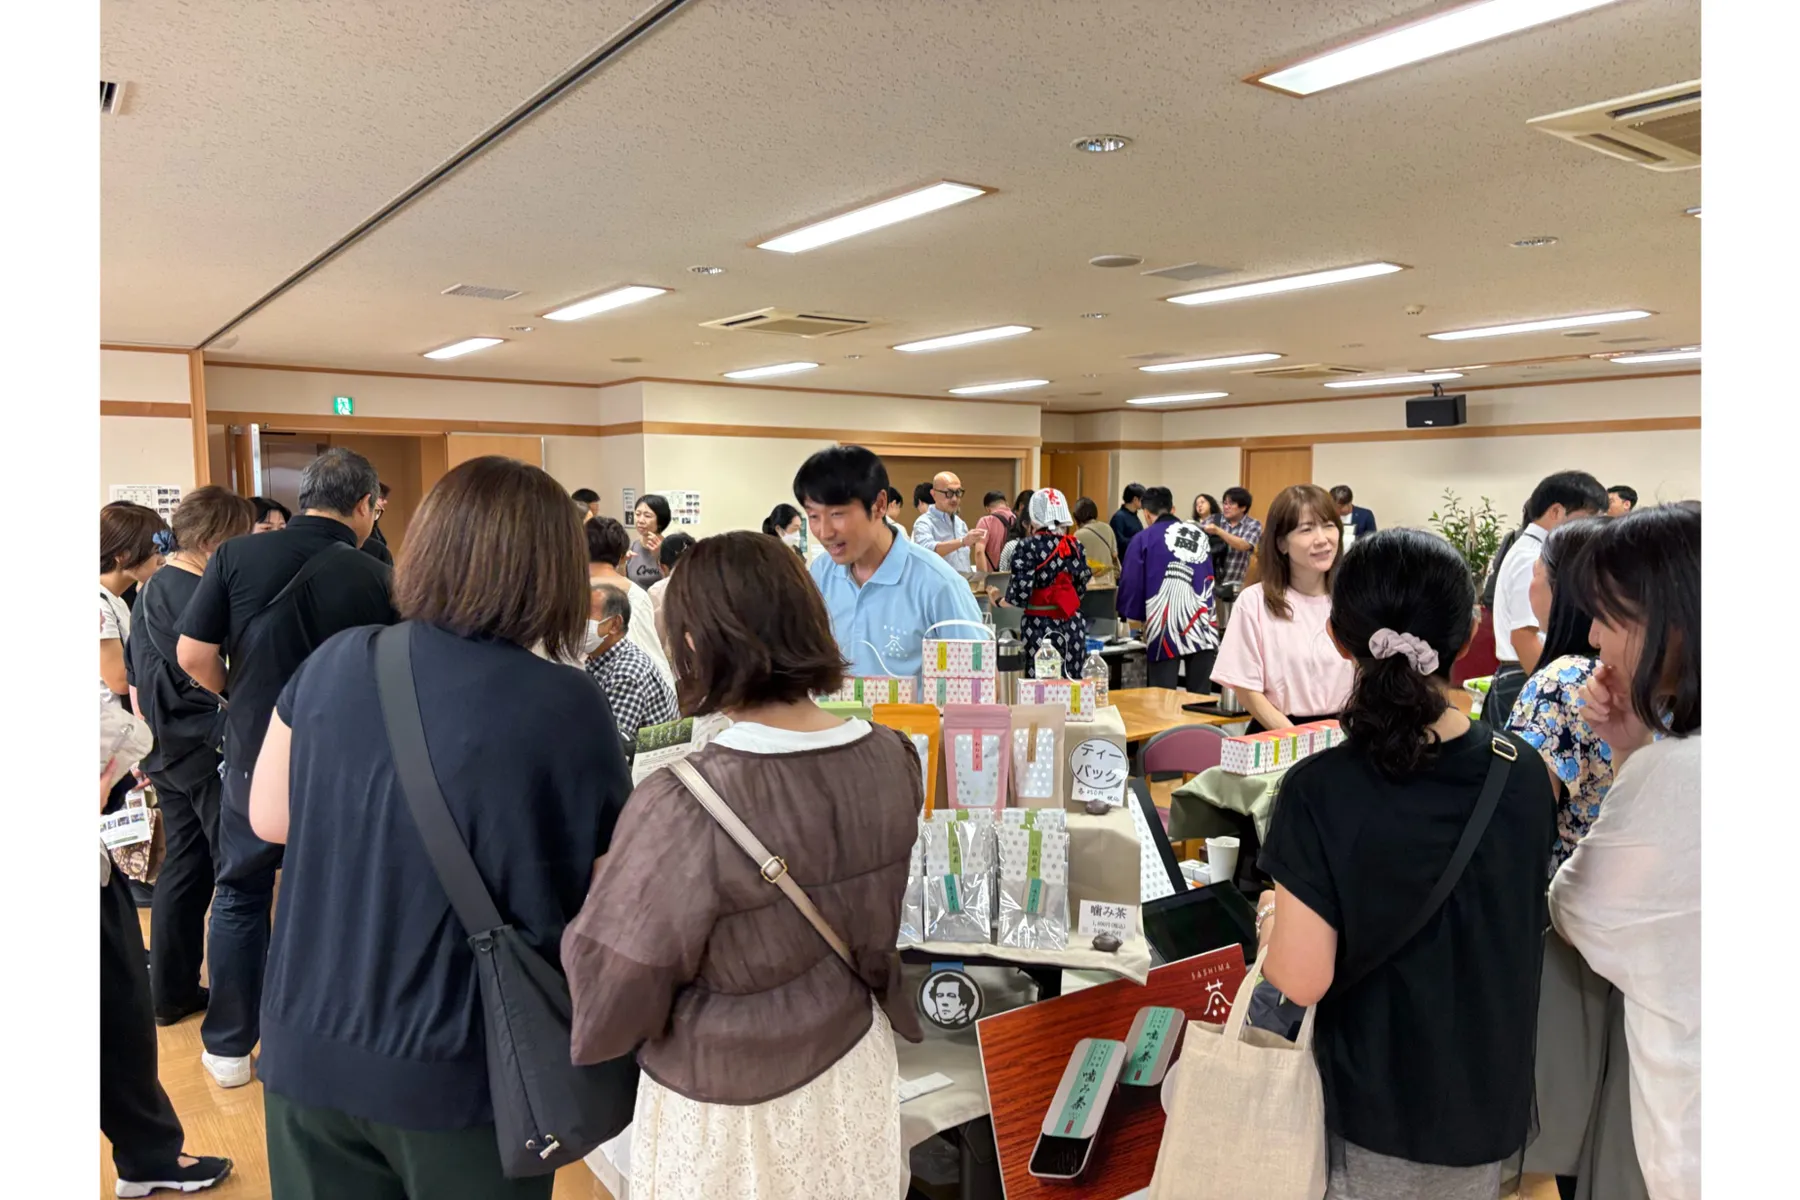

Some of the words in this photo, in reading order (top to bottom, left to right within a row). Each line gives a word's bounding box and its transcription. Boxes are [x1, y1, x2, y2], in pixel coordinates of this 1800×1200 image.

[1081, 743, 1122, 760] ティー
[1090, 904, 1127, 919] 噛み茶
[1191, 961, 1231, 981] SASHIMA
[1070, 1068, 1097, 1110] 噛み茶
